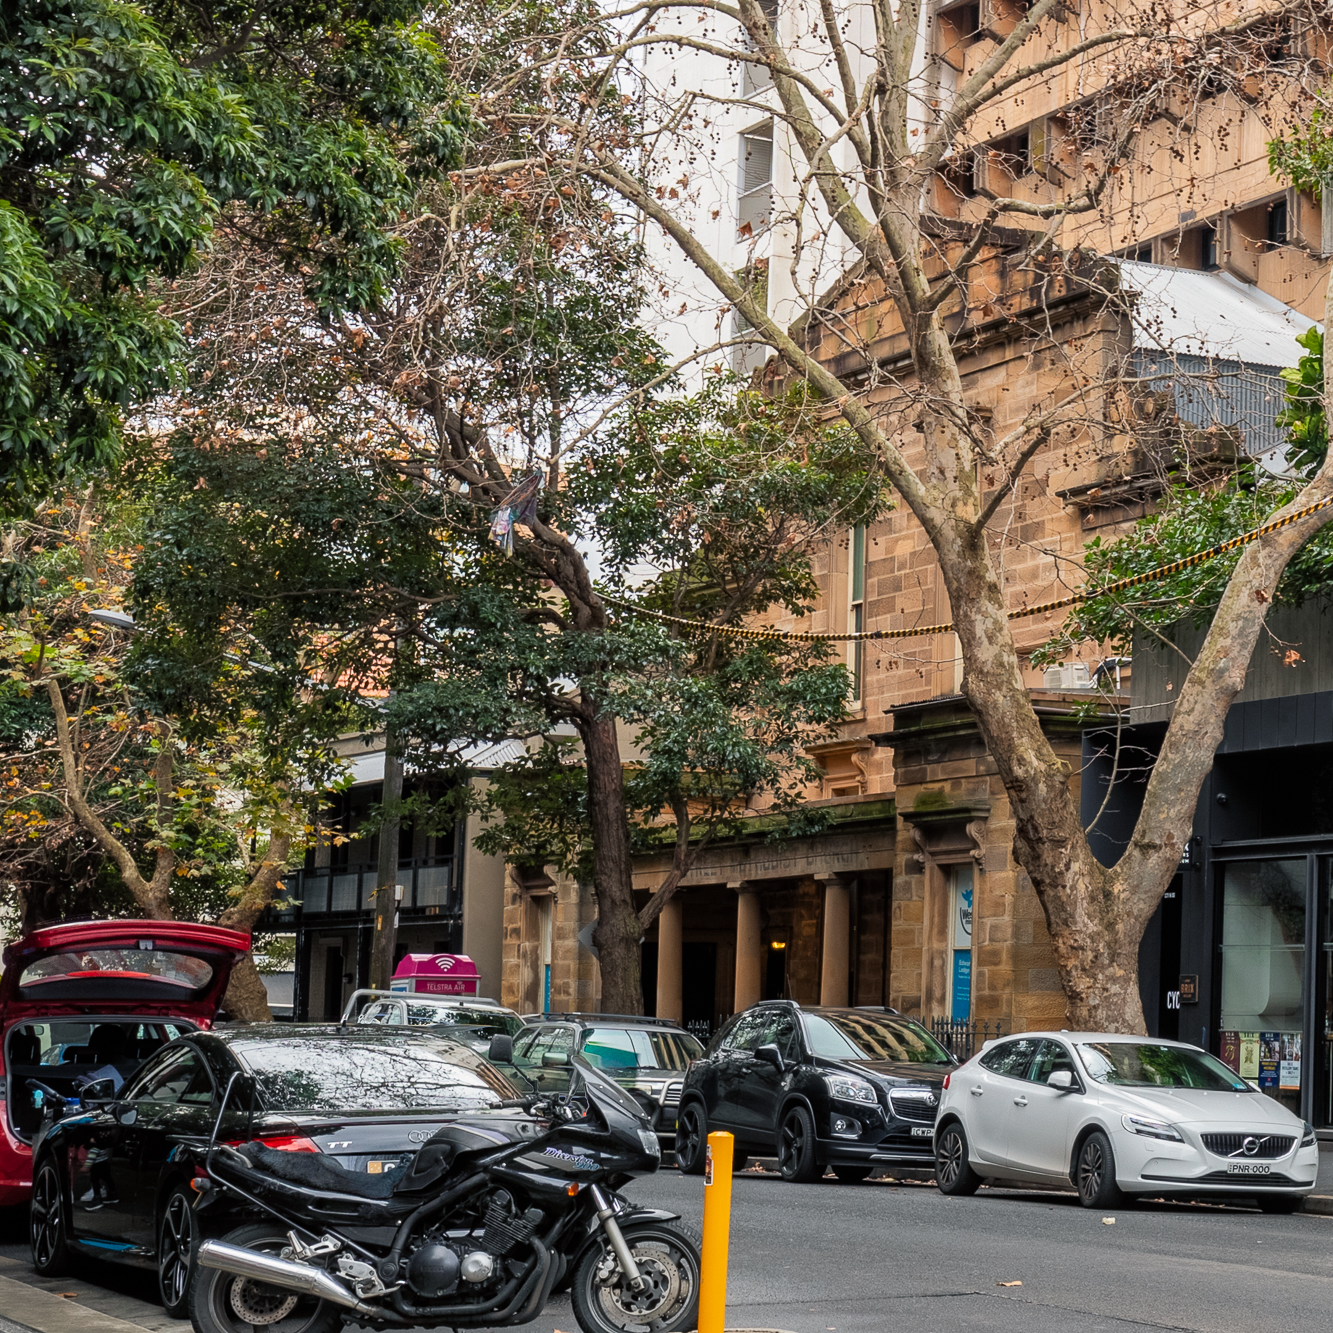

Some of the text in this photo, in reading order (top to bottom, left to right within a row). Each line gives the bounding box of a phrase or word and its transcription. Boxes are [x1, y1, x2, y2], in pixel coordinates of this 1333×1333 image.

[426, 983, 452, 991] TELSTRA
[327, 1140, 353, 1149] TT
[540, 1146, 594, 1165] Diversion
